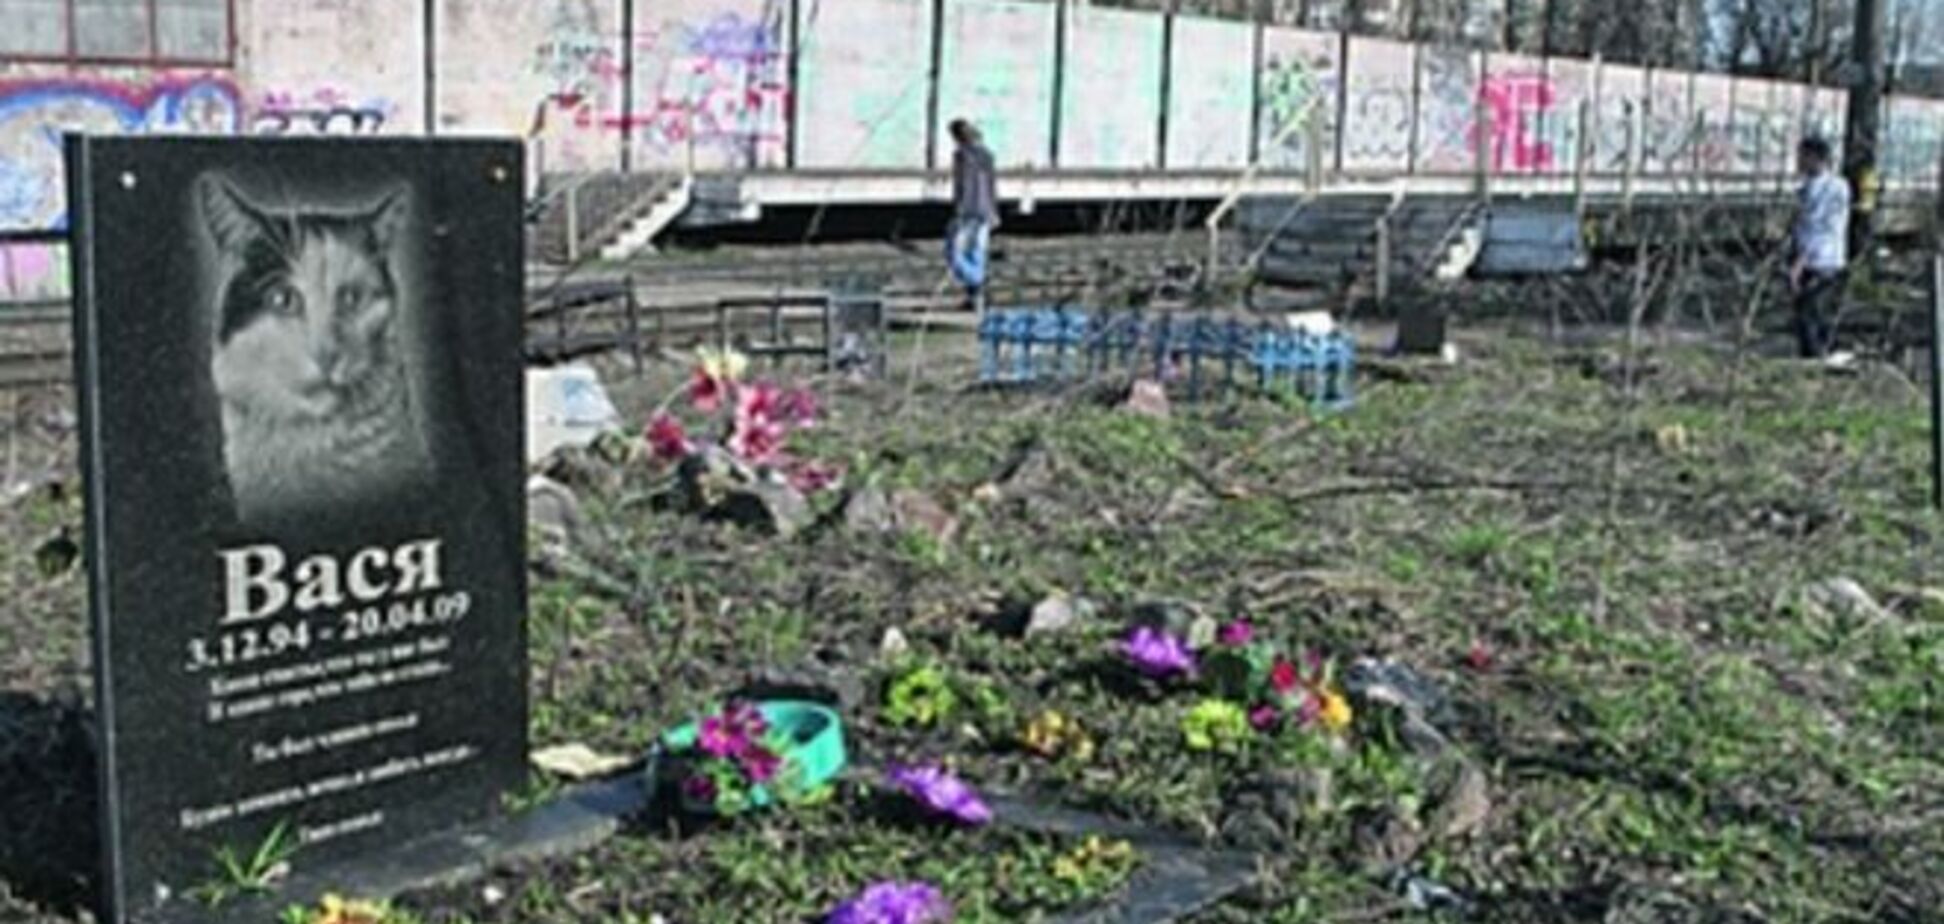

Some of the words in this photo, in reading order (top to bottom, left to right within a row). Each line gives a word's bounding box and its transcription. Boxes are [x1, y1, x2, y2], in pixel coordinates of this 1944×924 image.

[216, 537, 443, 625] Вася
[184, 619, 311, 672] 3.12.94
[341, 590, 472, 641] 20.04.09
